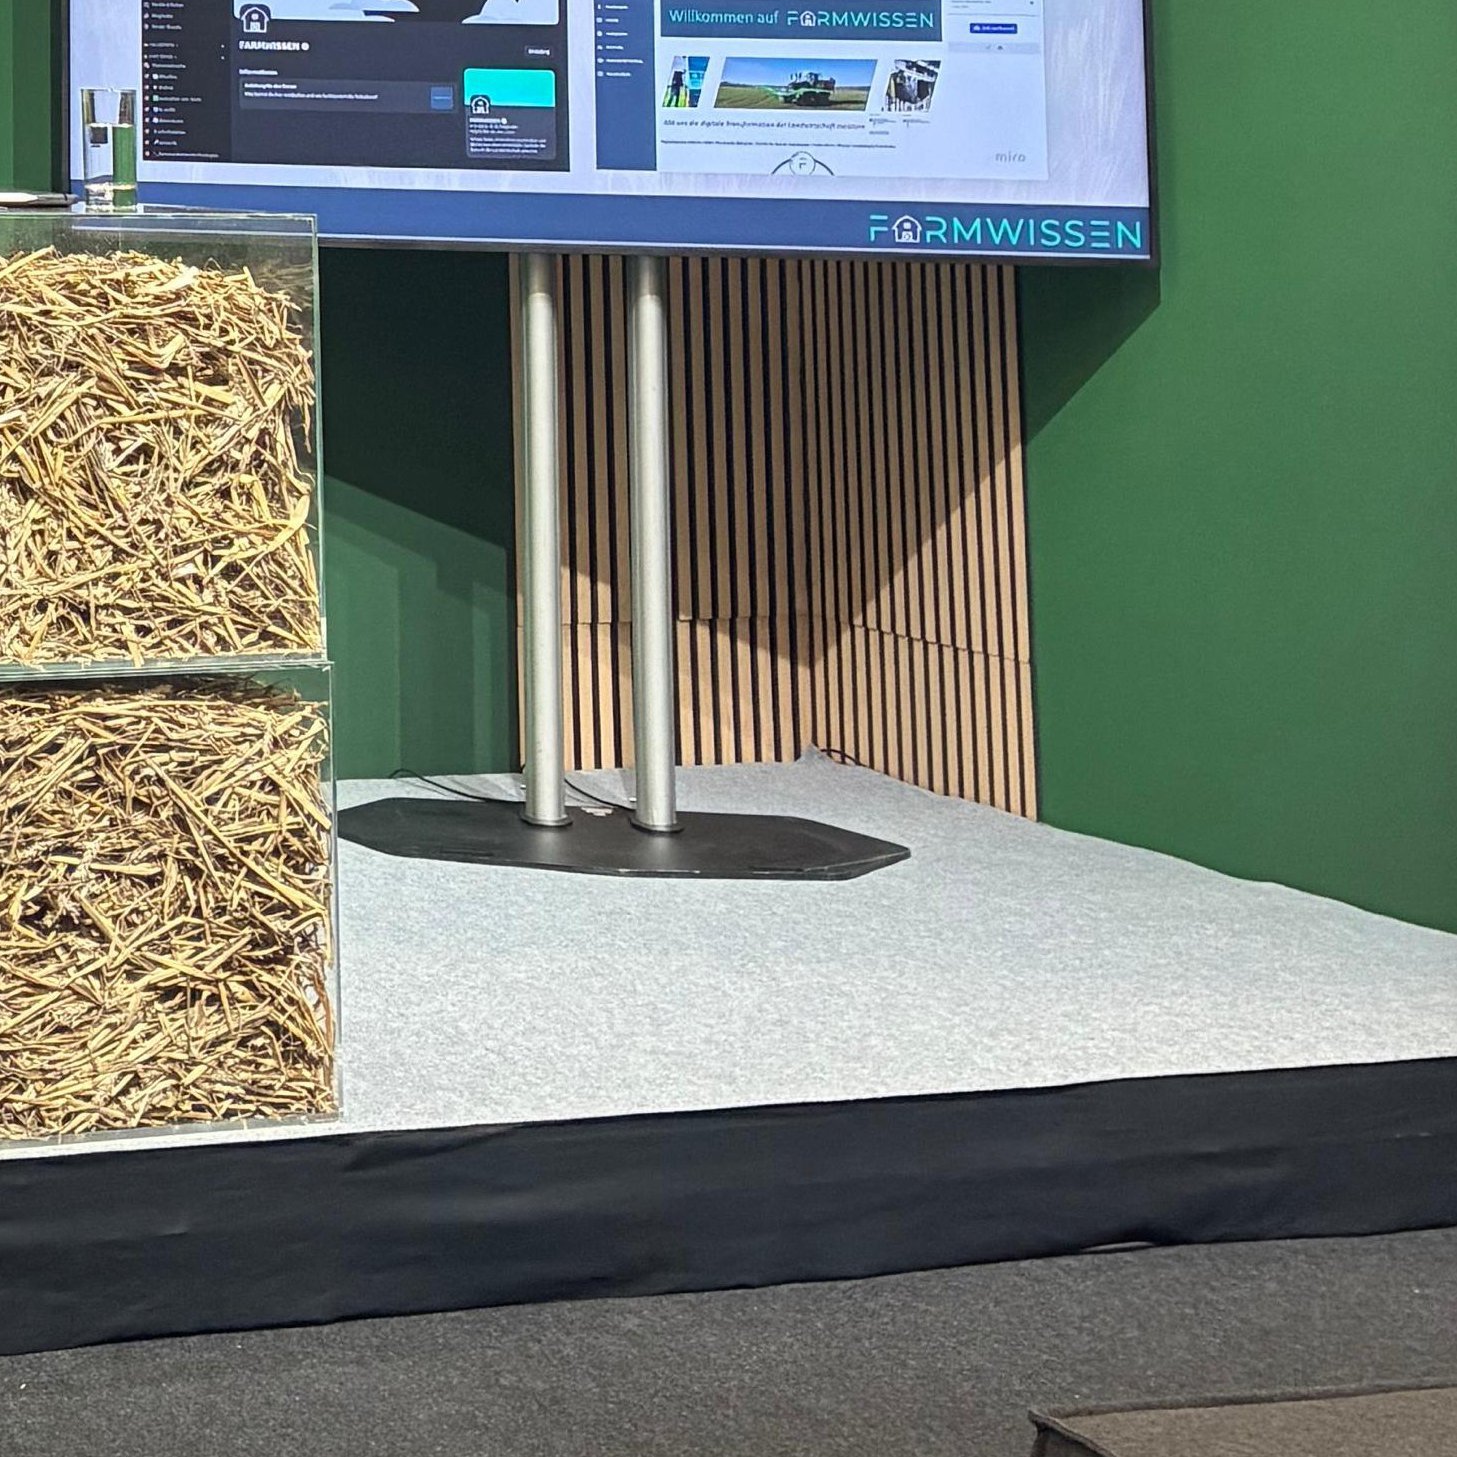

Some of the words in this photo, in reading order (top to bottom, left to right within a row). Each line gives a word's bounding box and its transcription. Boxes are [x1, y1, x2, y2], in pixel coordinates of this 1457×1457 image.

[669, 8, 754, 23] Willkommen
[757, 10, 780, 24] auf
[995, 150, 1026, 163] miro
